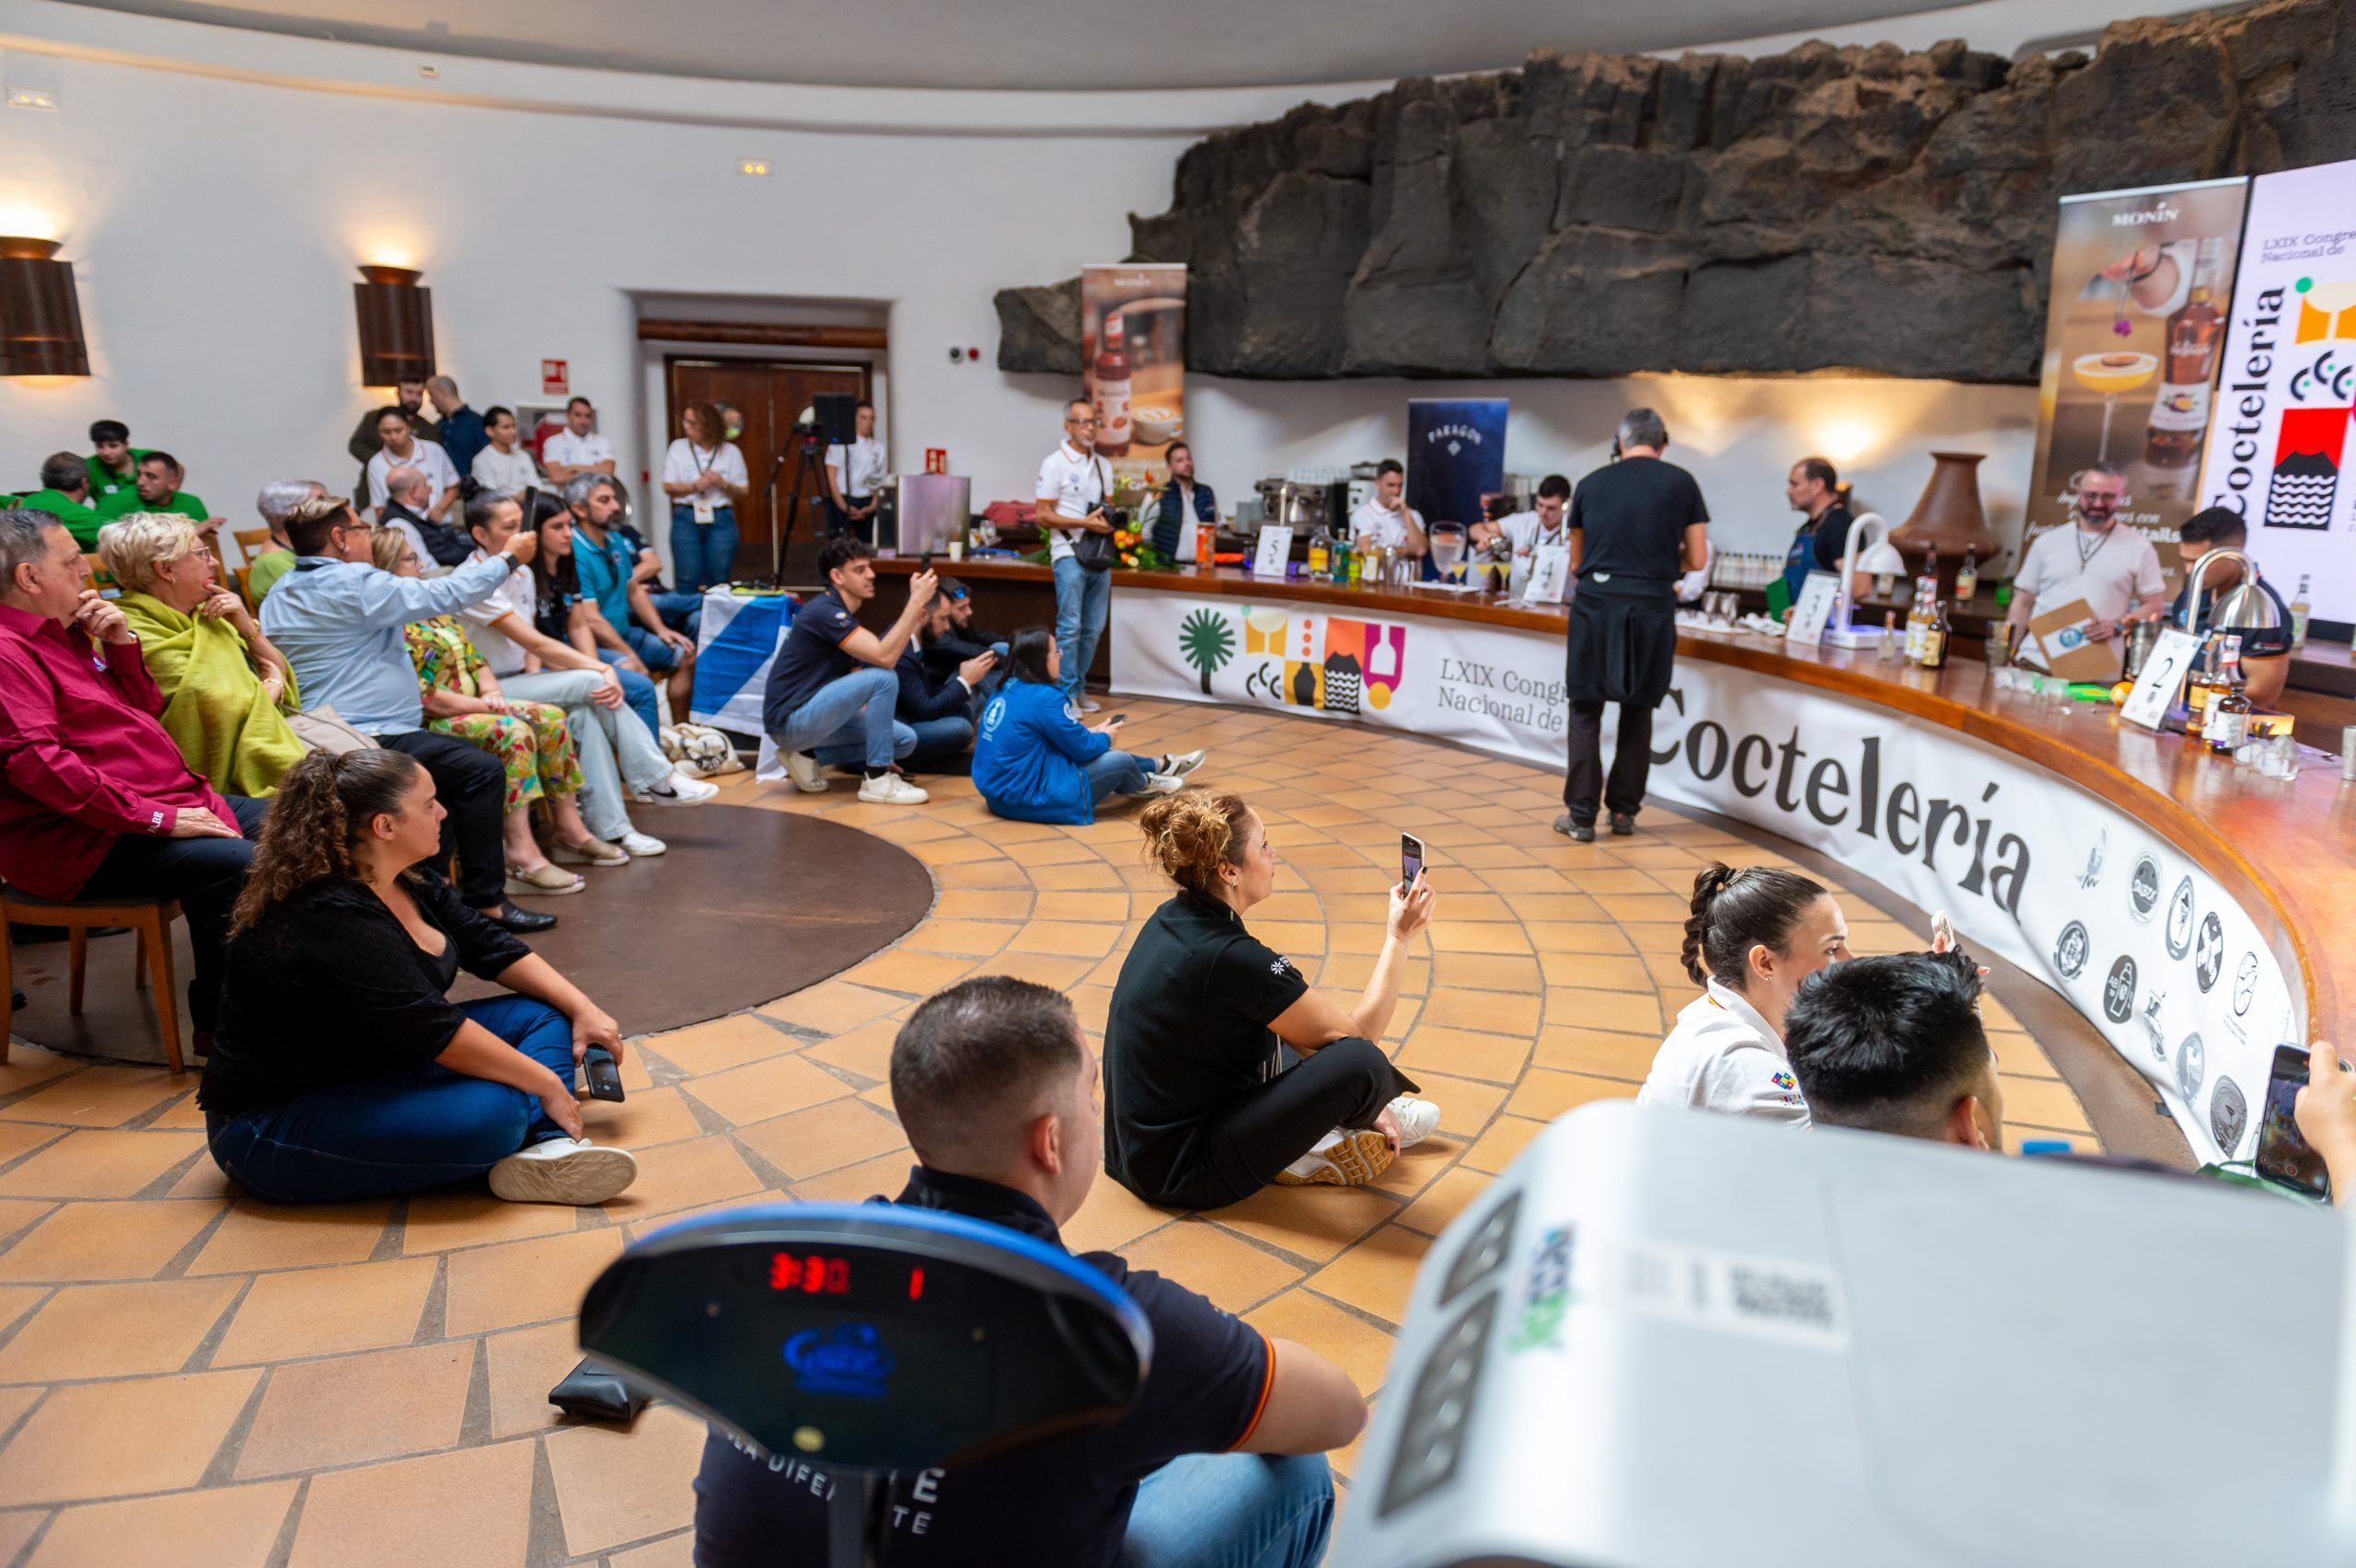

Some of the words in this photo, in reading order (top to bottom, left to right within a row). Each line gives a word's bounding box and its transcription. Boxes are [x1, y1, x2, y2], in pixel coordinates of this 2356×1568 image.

[2260, 245, 2325, 264] Nacional
[1541, 560, 1553, 580] 4
[1439, 657, 1496, 688] LXIX
[2151, 657, 2174, 688] 2
[1437, 686, 1534, 726] Nacional
[1537, 707, 1564, 732] de
